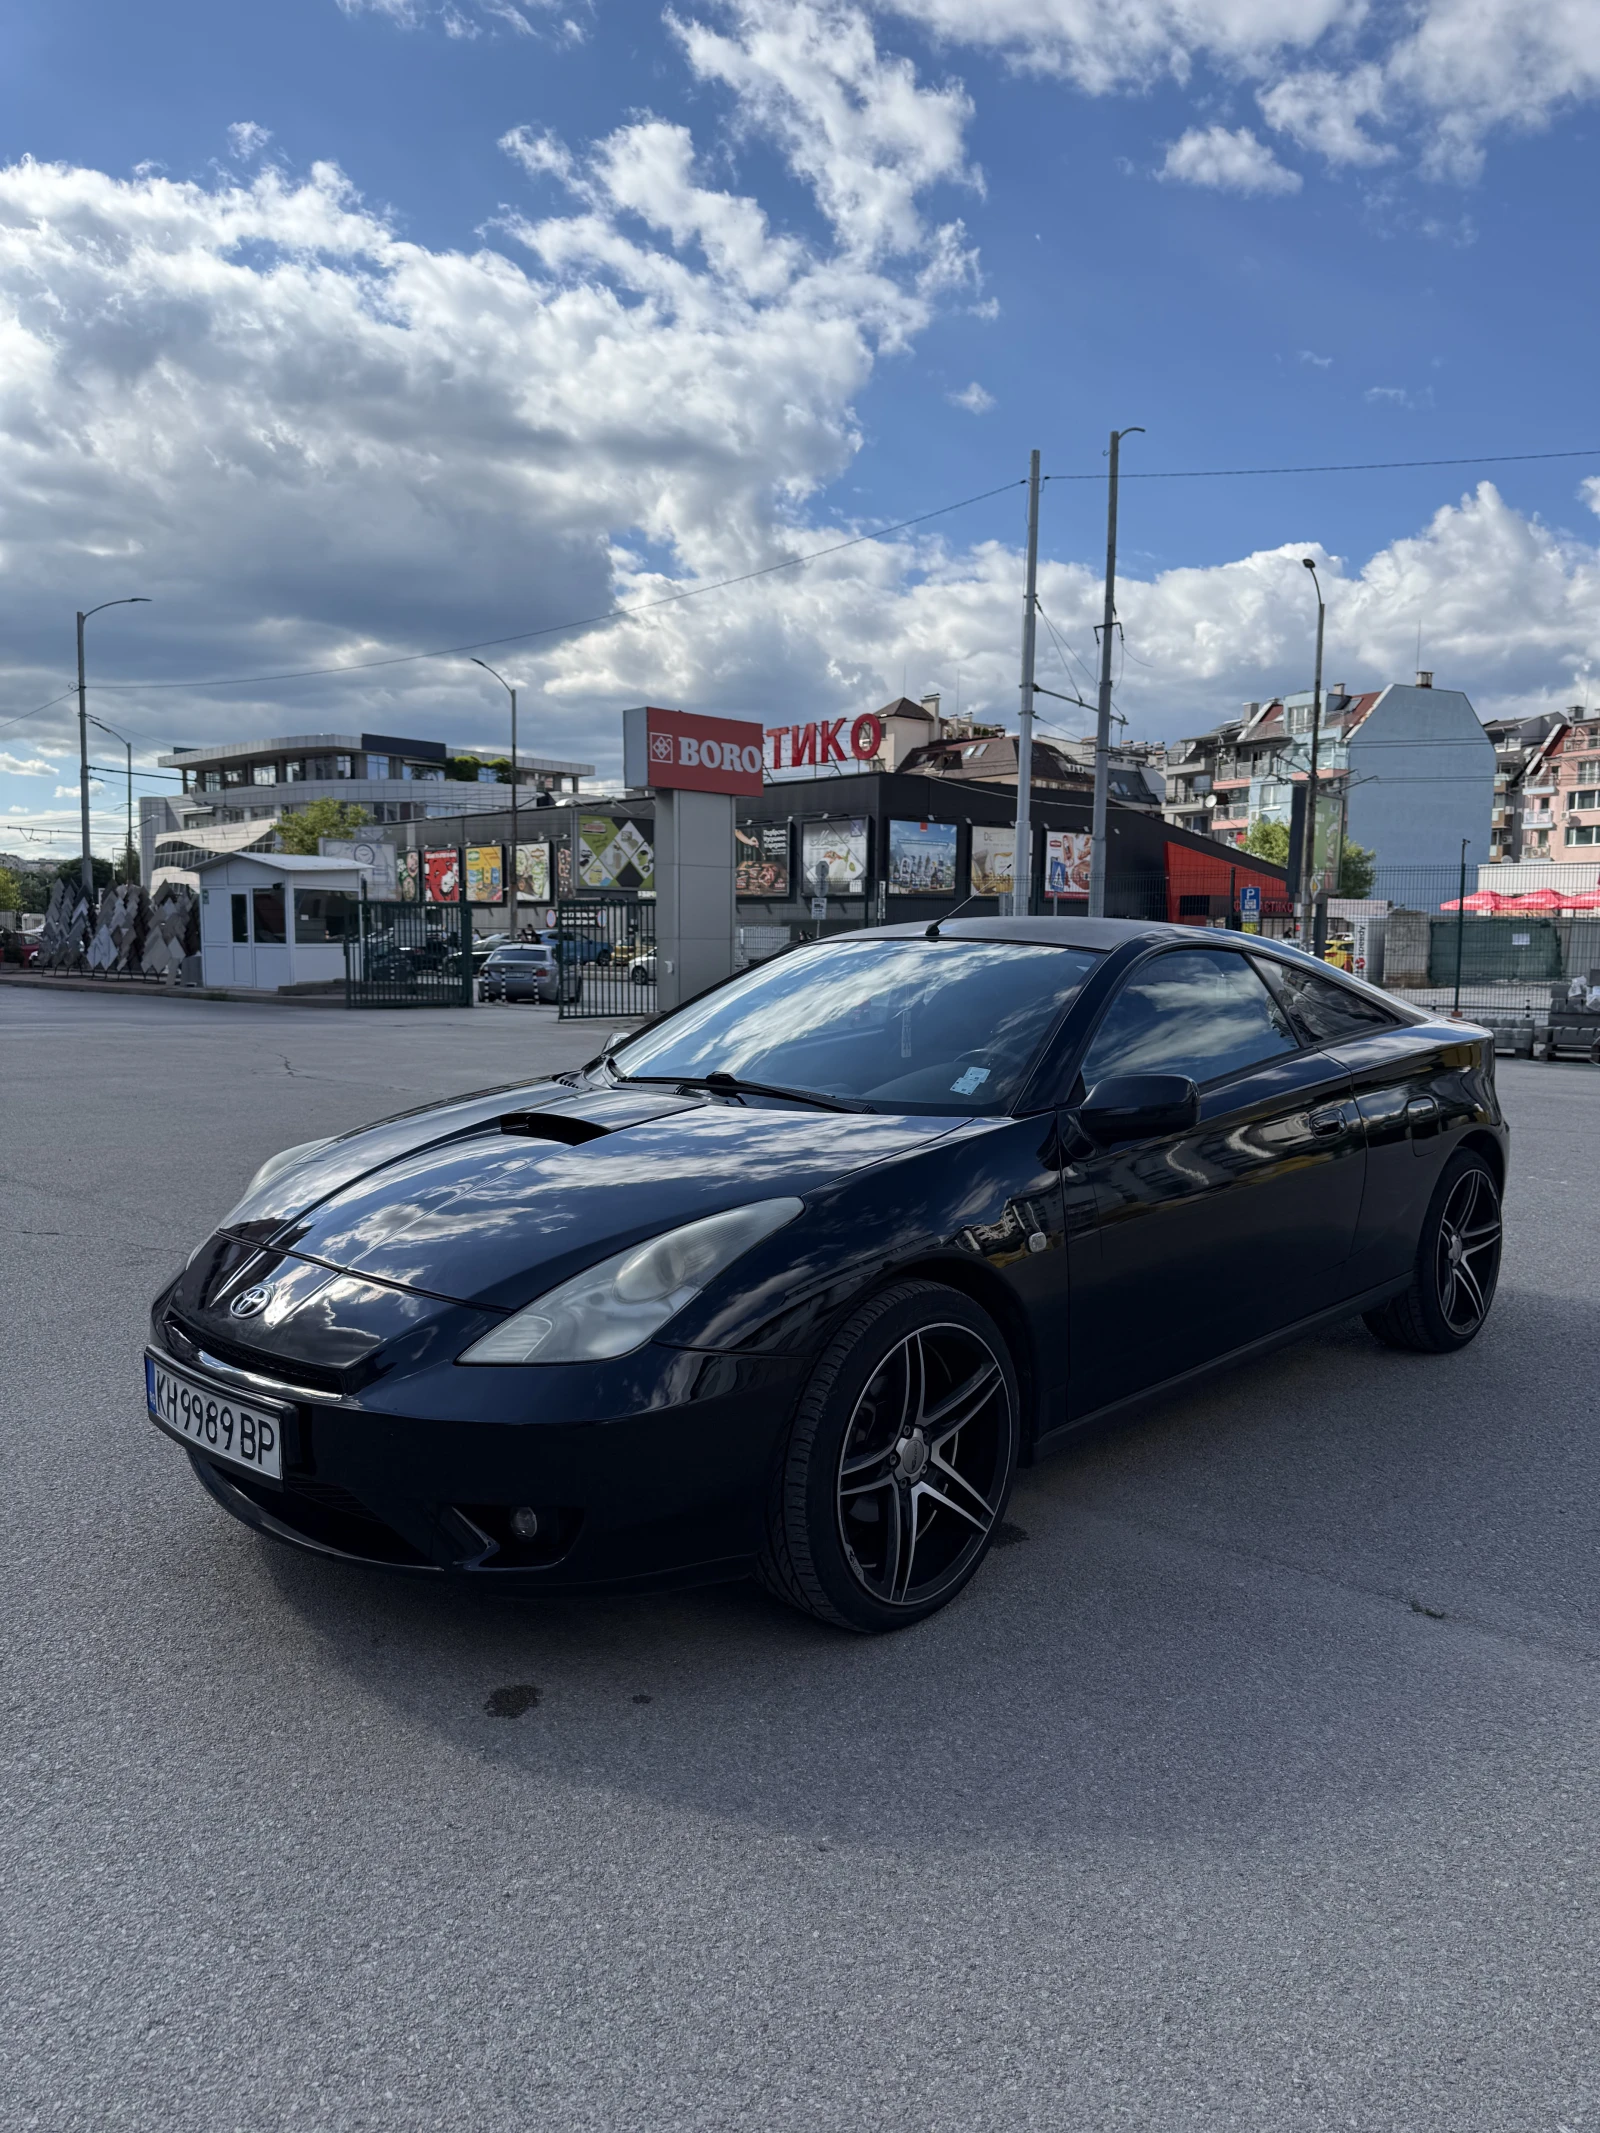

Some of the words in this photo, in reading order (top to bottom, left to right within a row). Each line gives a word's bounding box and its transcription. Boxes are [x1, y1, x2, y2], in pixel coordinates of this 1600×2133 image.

[678, 736, 763, 774] BORO
[1246, 889, 1255, 900] P
[1358, 925, 1366, 956] speedy
